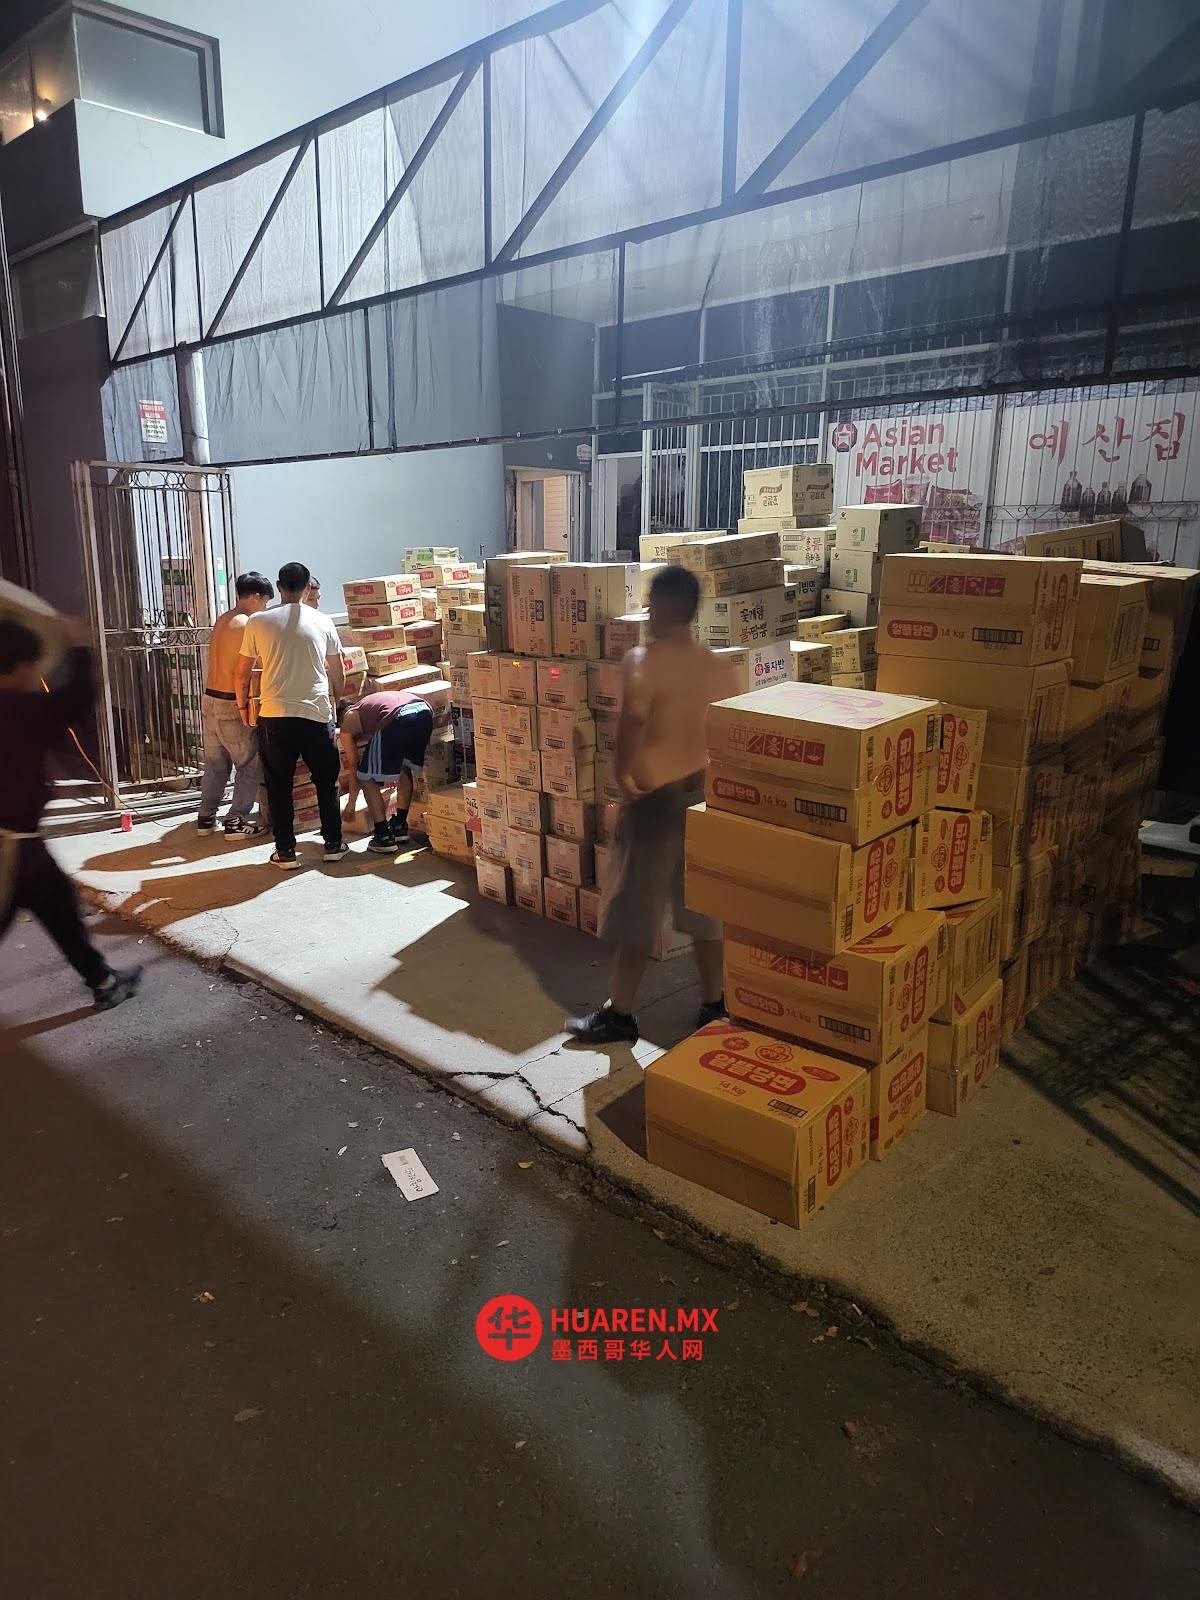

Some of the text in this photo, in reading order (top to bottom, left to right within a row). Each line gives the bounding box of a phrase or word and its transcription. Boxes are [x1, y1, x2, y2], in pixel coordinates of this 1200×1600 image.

[862, 420, 944, 449] Asian
[855, 448, 958, 478] Market
[942, 628, 951, 638] 14
[952, 628, 965, 640] kg
[763, 794, 773, 805] 14
[775, 796, 788, 809] kg
[719, 1080, 746, 1097] 14 kg
